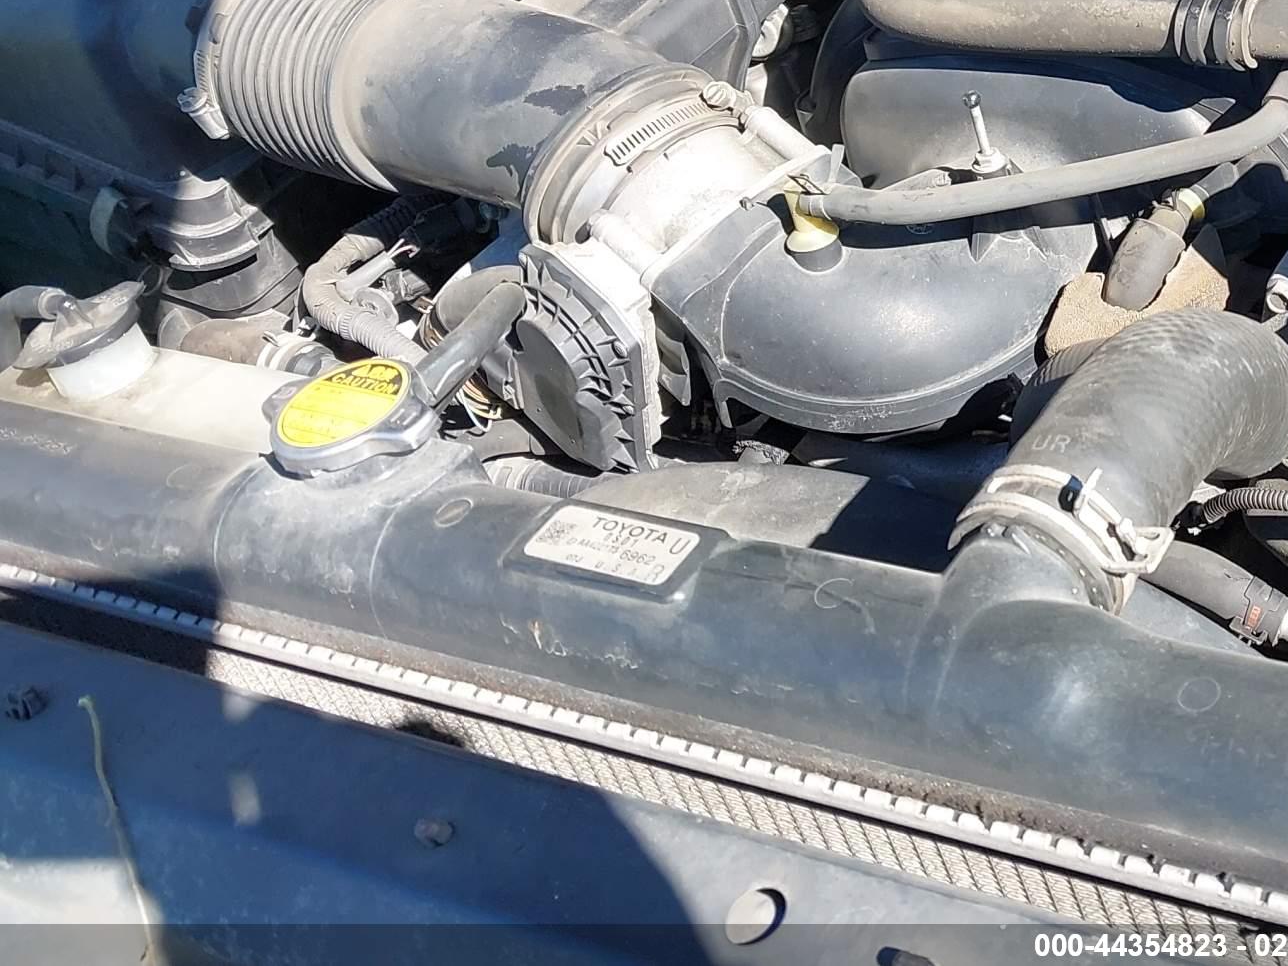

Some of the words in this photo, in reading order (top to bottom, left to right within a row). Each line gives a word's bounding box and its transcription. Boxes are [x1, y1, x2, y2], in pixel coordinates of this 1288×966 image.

[331, 373, 399, 395] CAUTION
[1031, 435, 1071, 452] UR
[592, 517, 669, 543] TOYOTA
[669, 537, 692, 555] U
